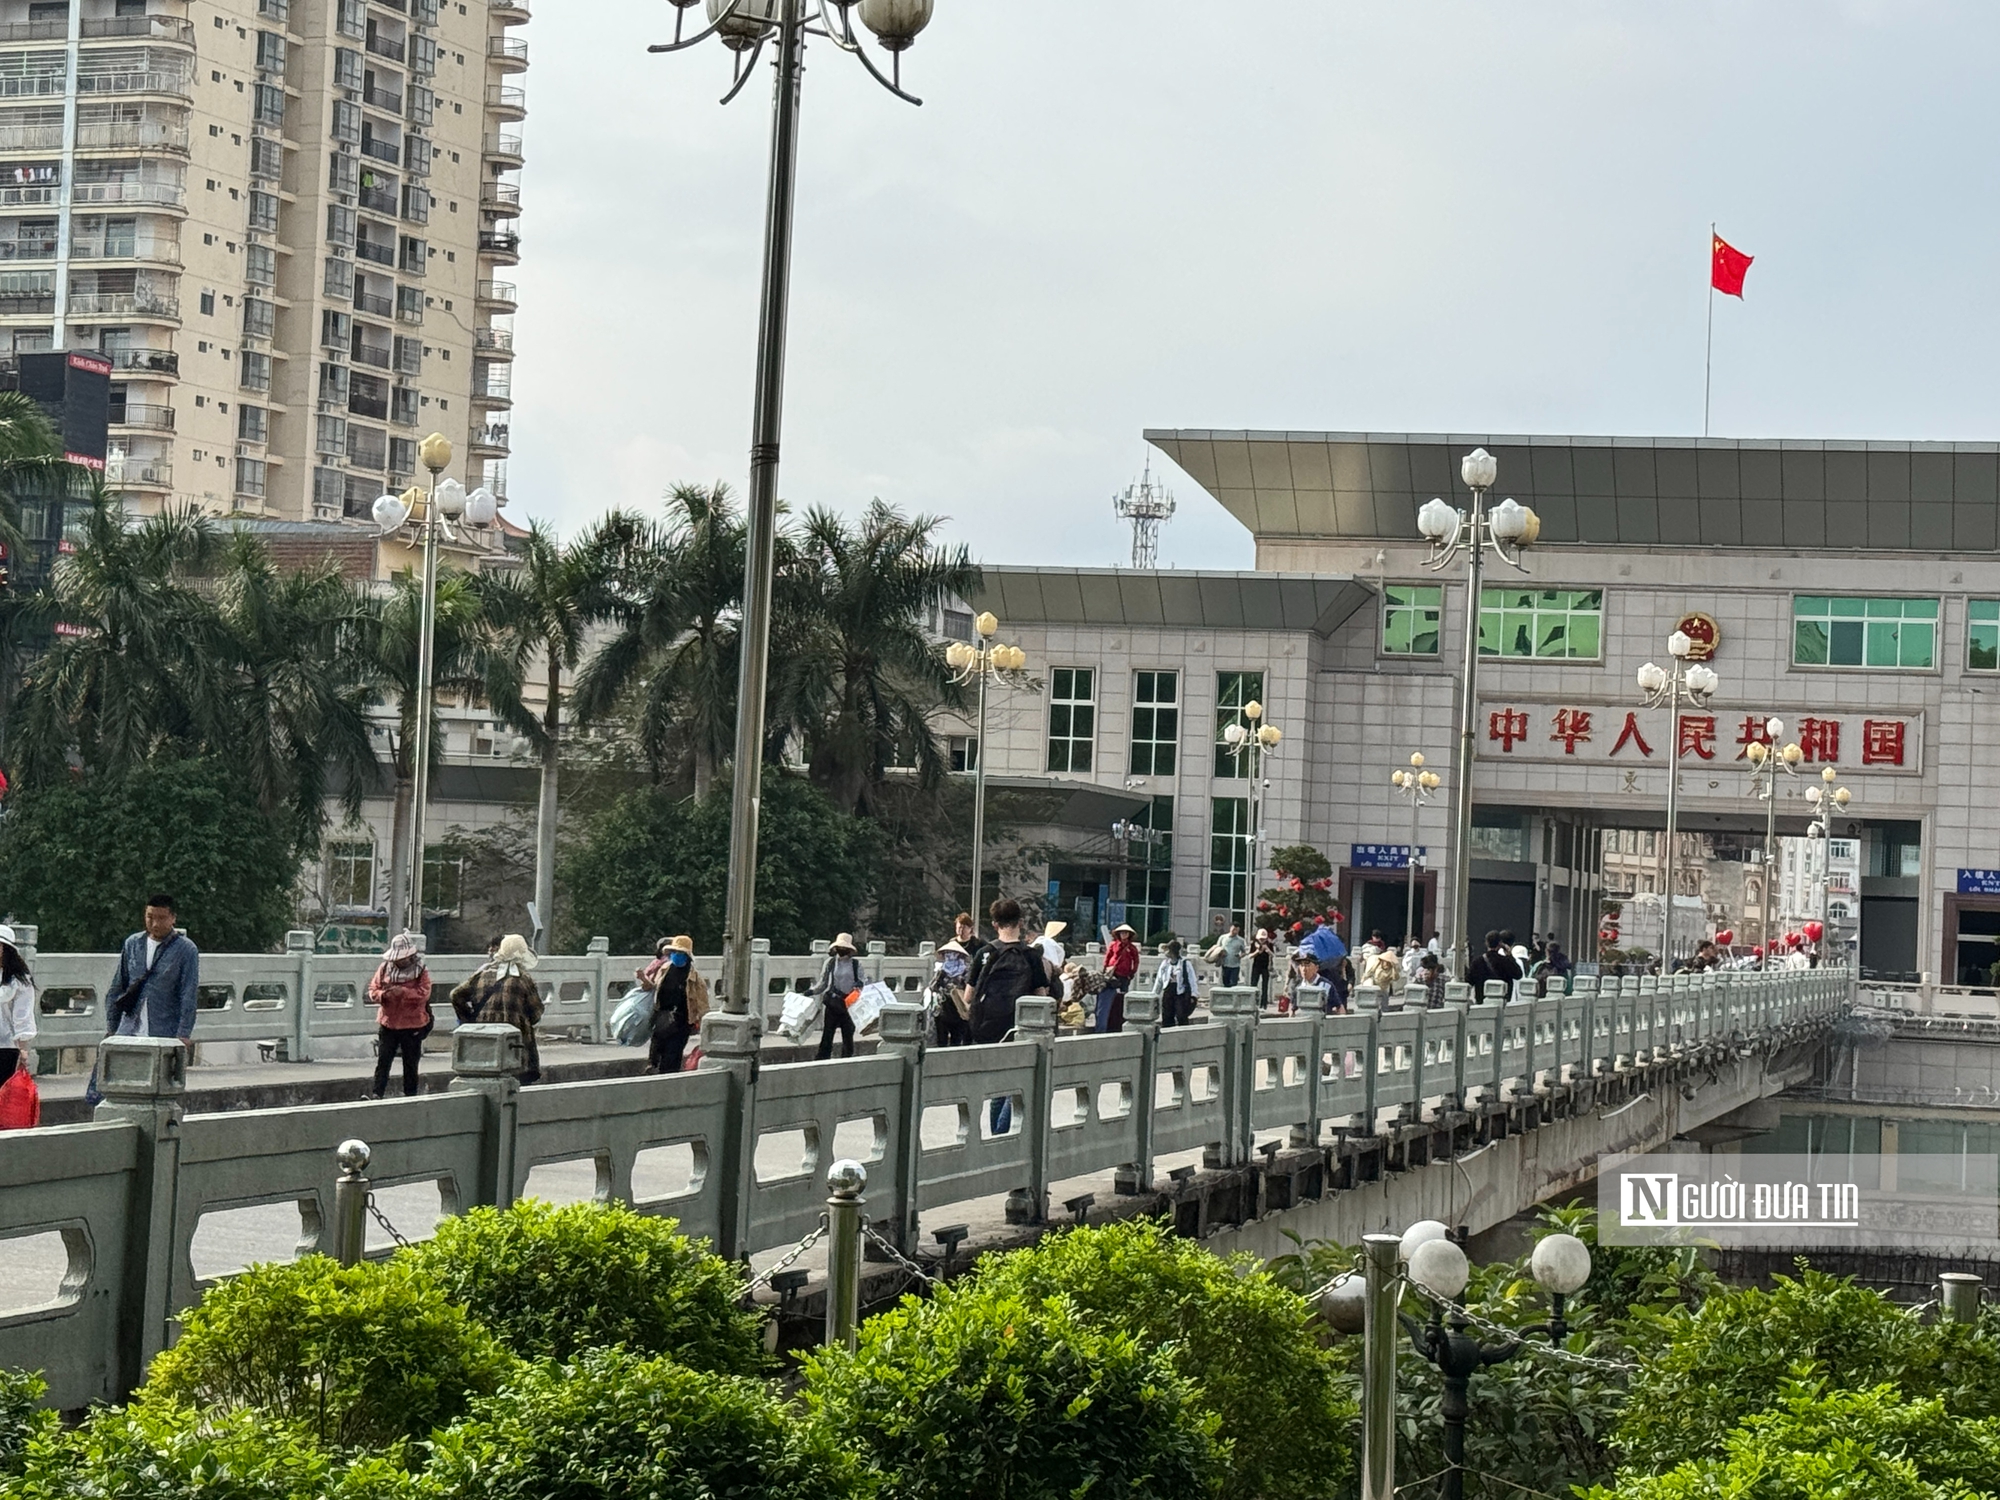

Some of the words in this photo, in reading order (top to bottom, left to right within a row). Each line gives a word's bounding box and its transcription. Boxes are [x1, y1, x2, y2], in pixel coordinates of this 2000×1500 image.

[1490, 707, 1905, 766] 中华人民共和国
